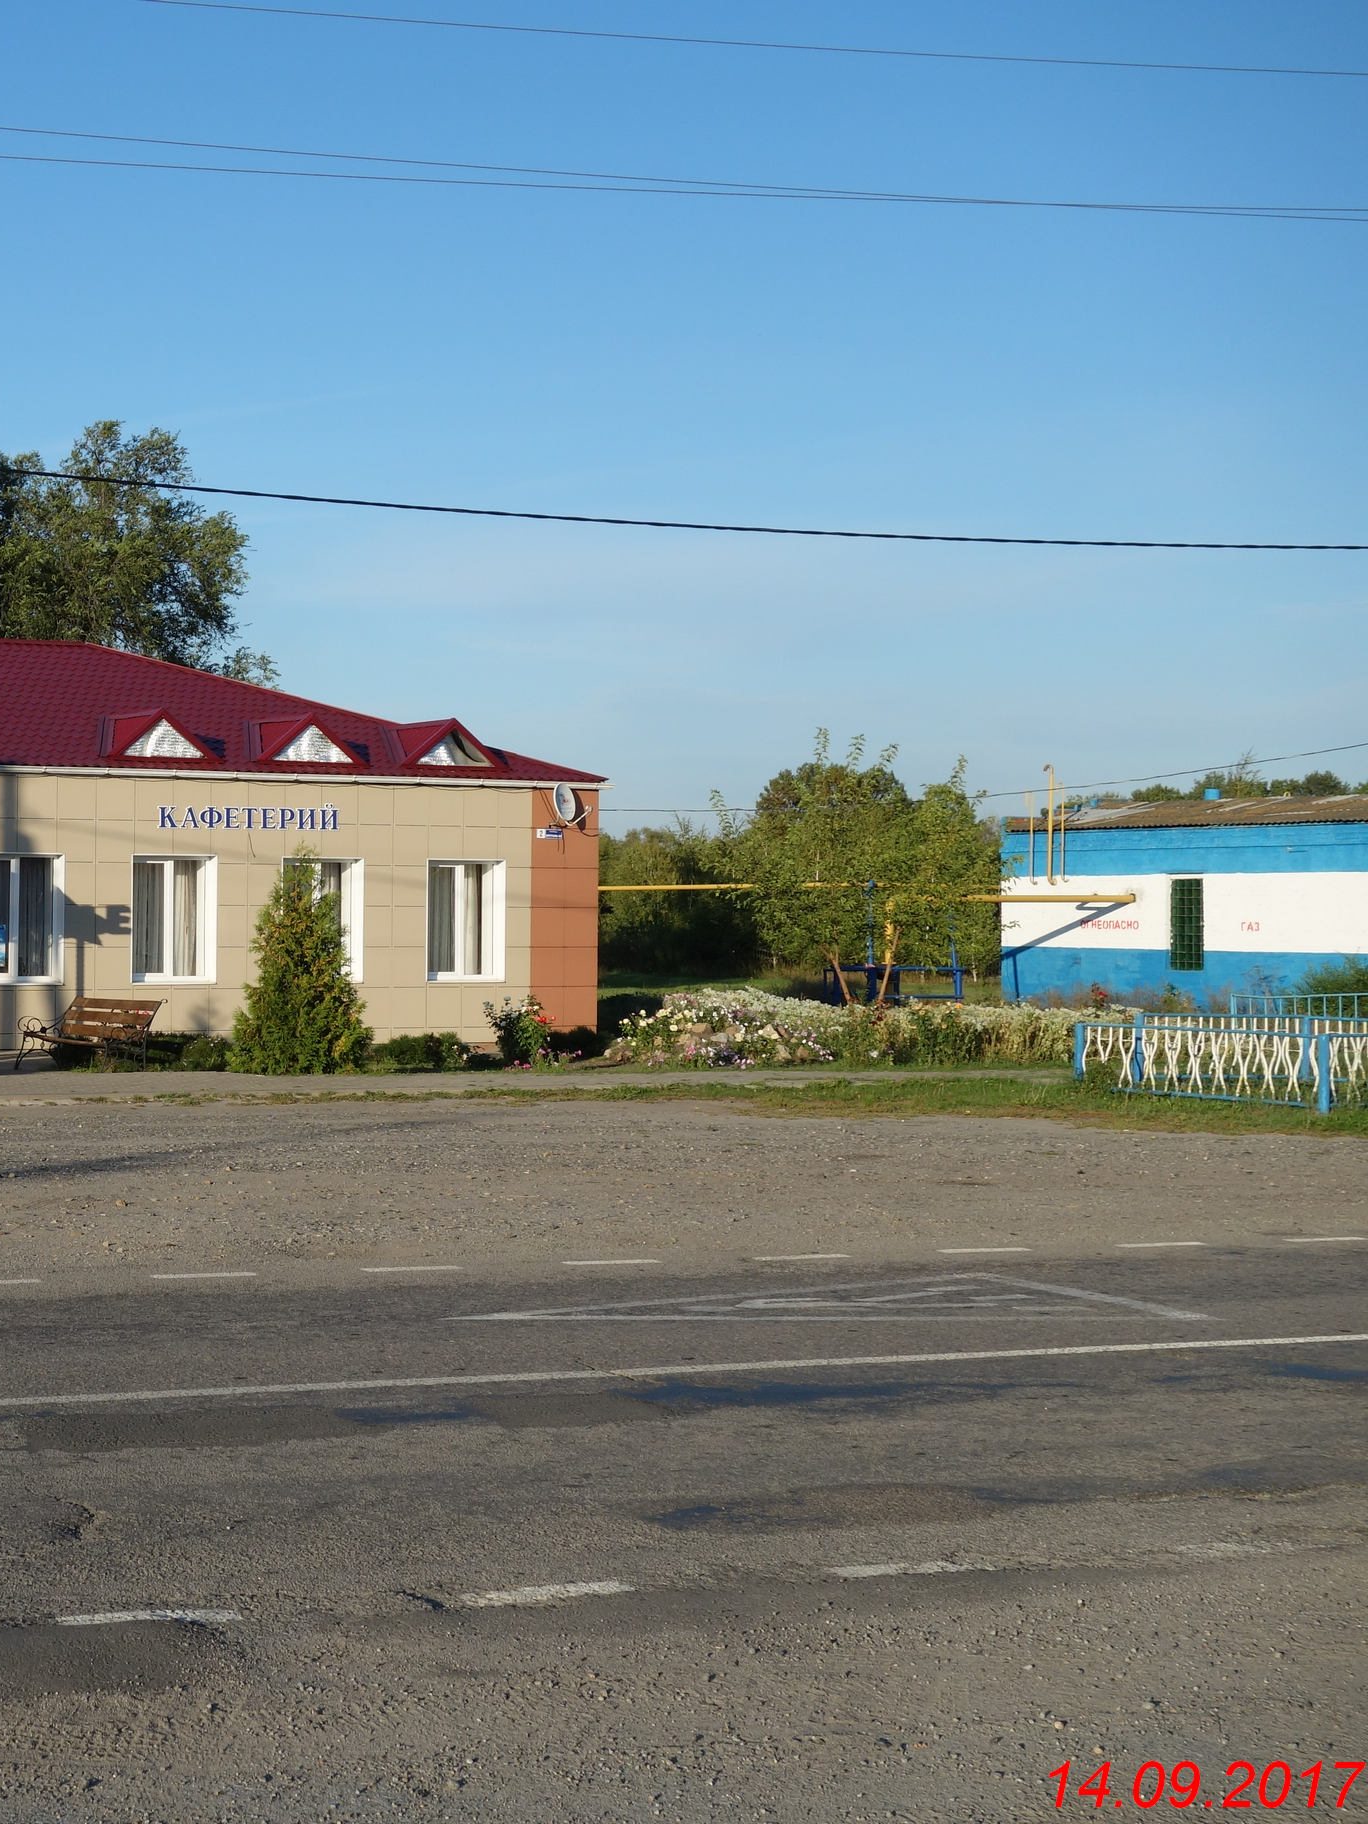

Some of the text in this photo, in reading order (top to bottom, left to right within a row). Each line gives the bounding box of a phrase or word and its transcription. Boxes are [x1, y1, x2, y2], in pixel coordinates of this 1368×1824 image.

[157, 803, 340, 831] КАФЕТЕРИЙ
[1080, 920, 1140, 931] ОГНЕОПАСНО
[1240, 921, 1261, 932] ГАЗ
